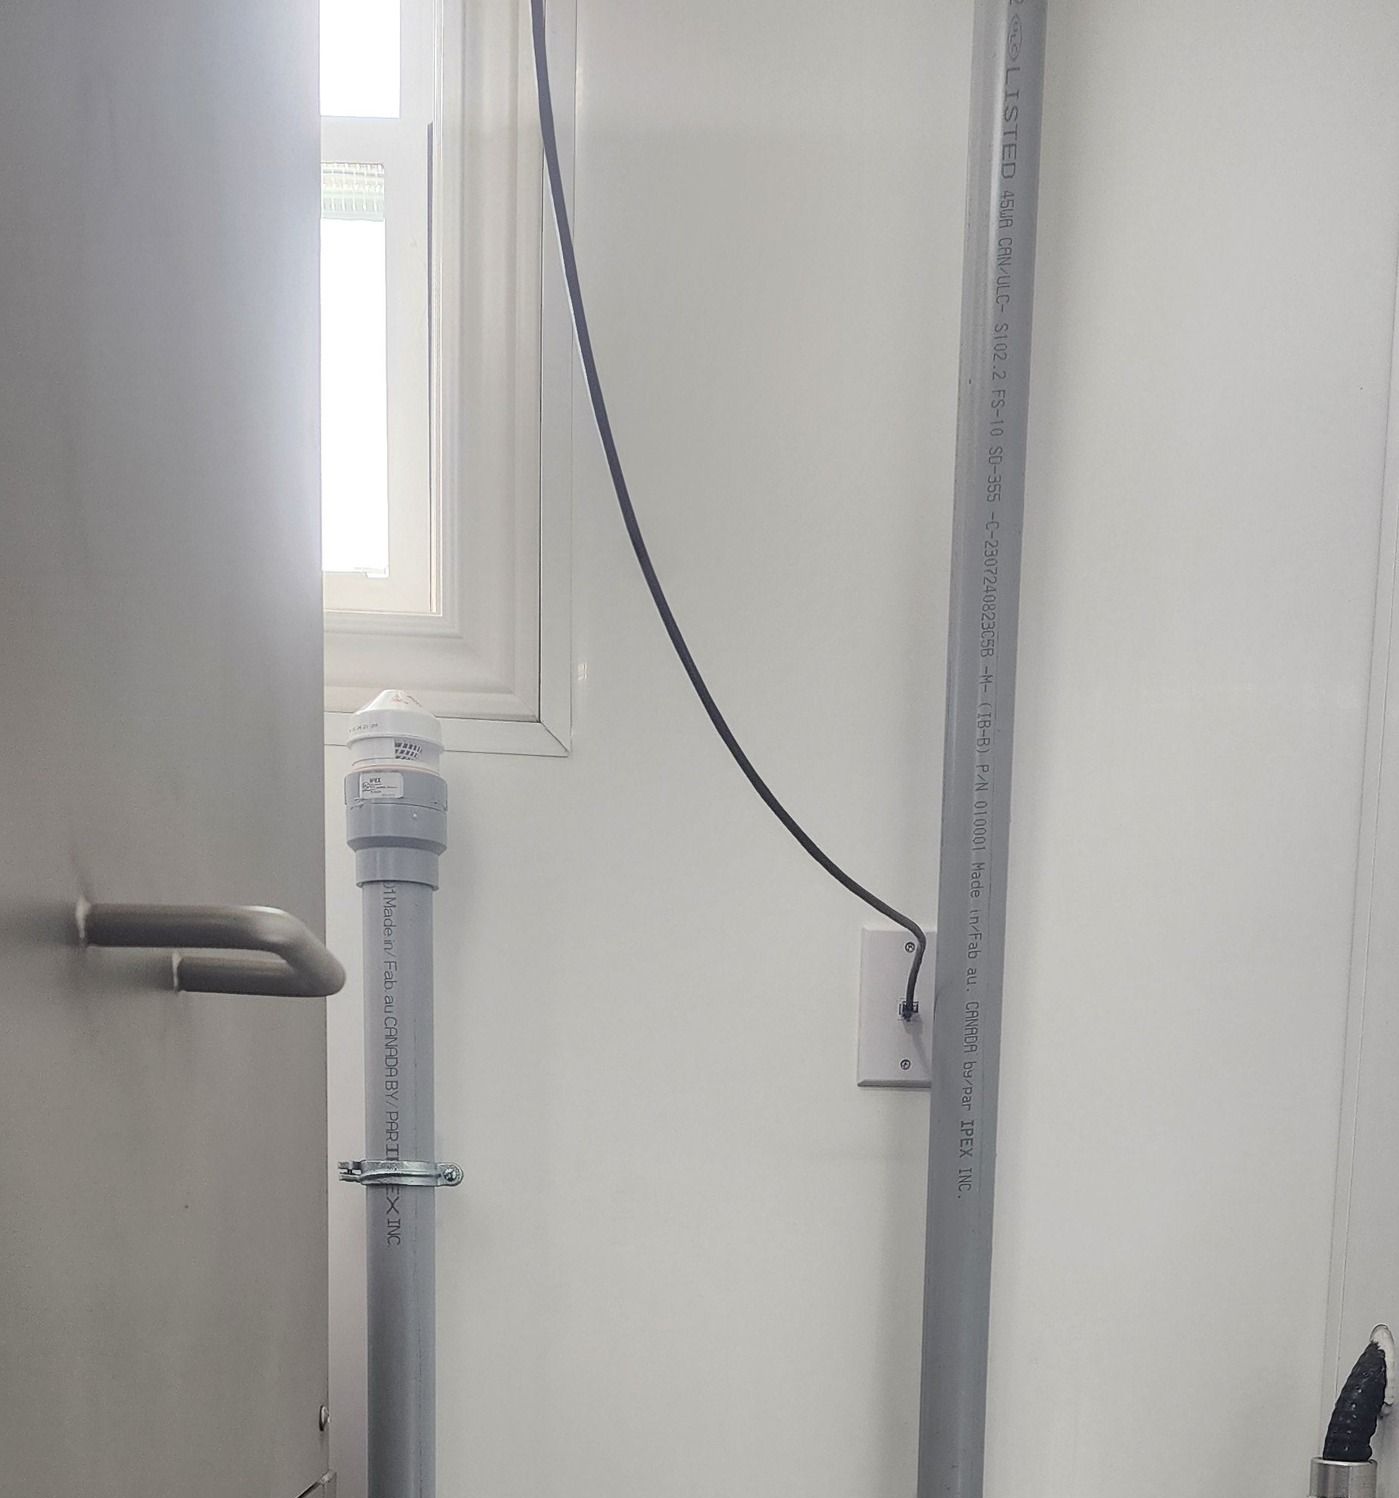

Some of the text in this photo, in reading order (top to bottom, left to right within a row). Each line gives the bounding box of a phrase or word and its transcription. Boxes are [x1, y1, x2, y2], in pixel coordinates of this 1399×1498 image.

[1001, 66, 1021, 179] LISTED
[998, 190, 1014, 230] 45WA
[991, 322, 1010, 380] S102.2
[989, 389, 1006, 437] FS-10
[986, 446, 1003, 502] SD-355
[975, 764, 989, 792] P/N
[972, 800, 987, 851] 010001
[969, 862, 985, 899] Made
[383, 897, 397, 937] Made
[384, 1016, 399, 1077] CANADA
[963, 1001, 979, 1054] CANADA
[959, 1120, 975, 1159] IPEX
[957, 1168, 972, 1200] INC.
